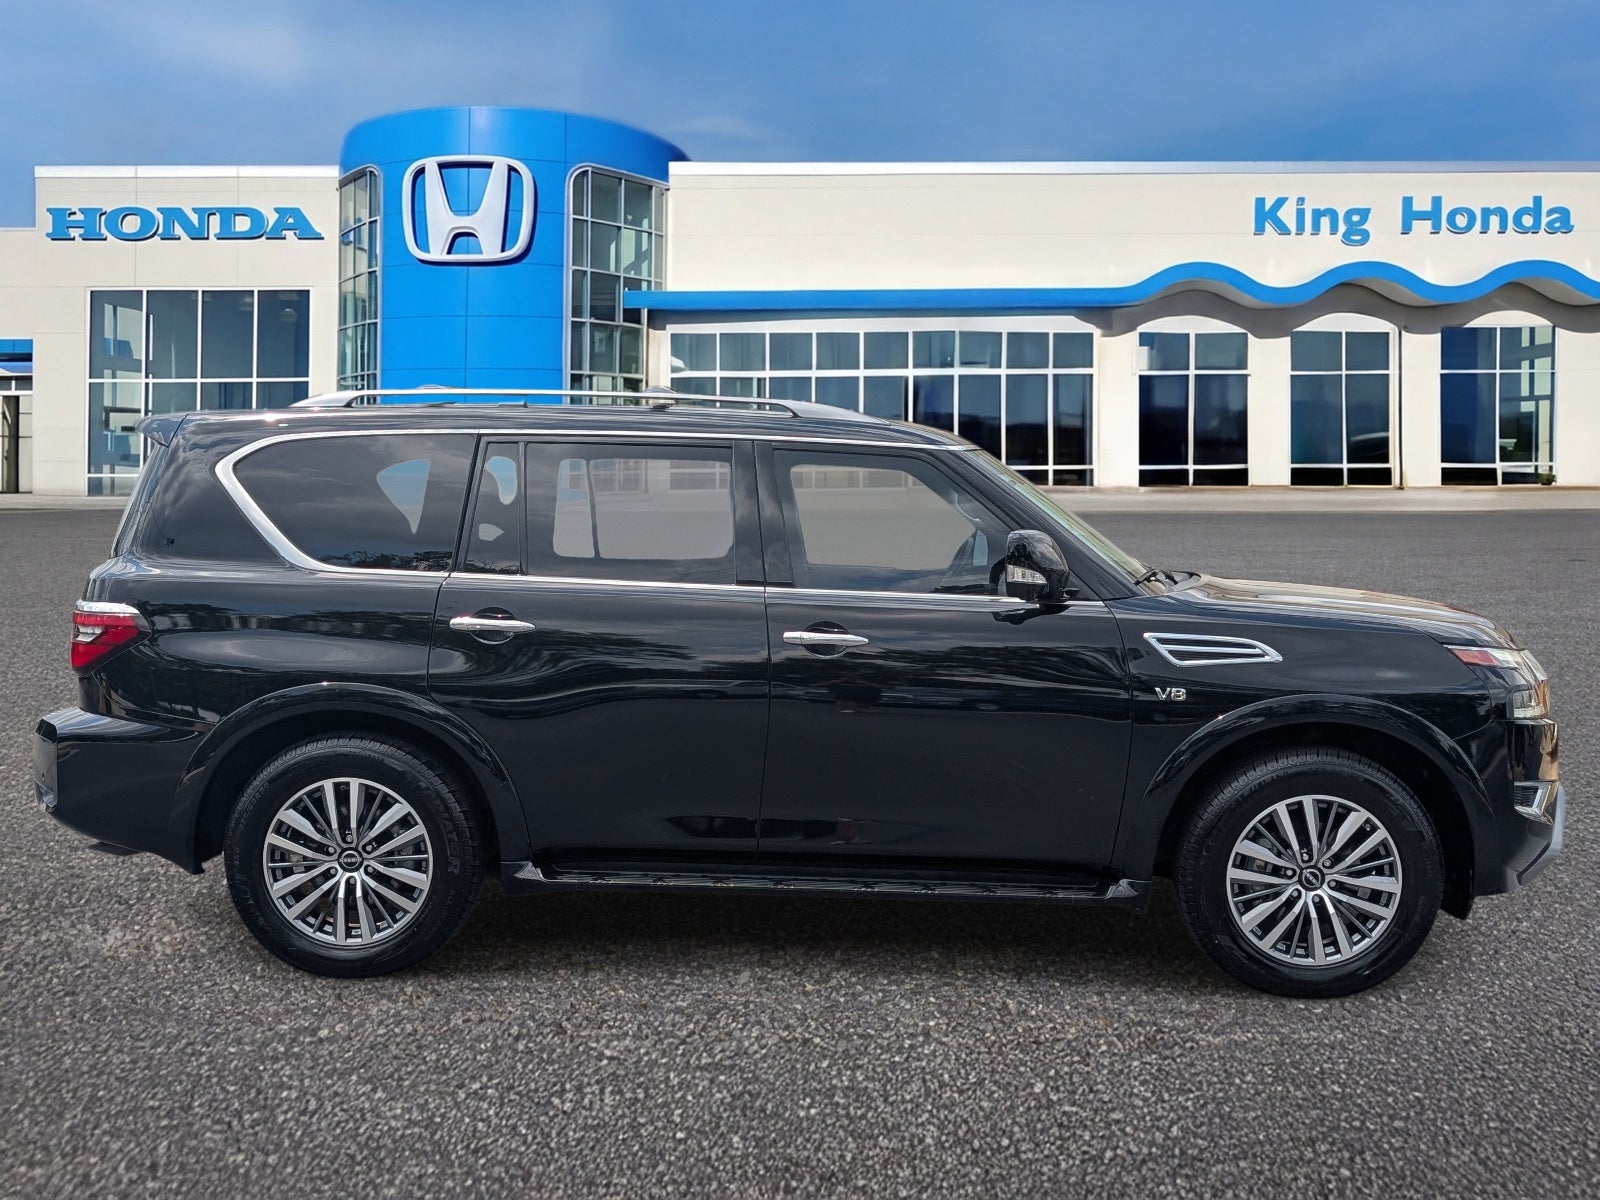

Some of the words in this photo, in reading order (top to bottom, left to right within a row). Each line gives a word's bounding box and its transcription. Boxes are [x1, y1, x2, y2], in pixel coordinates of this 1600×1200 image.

[45, 206, 325, 240] HONDA
[1253, 196, 1371, 246] King
[1400, 195, 1575, 234] Honda
[1155, 687, 1187, 701] V8
